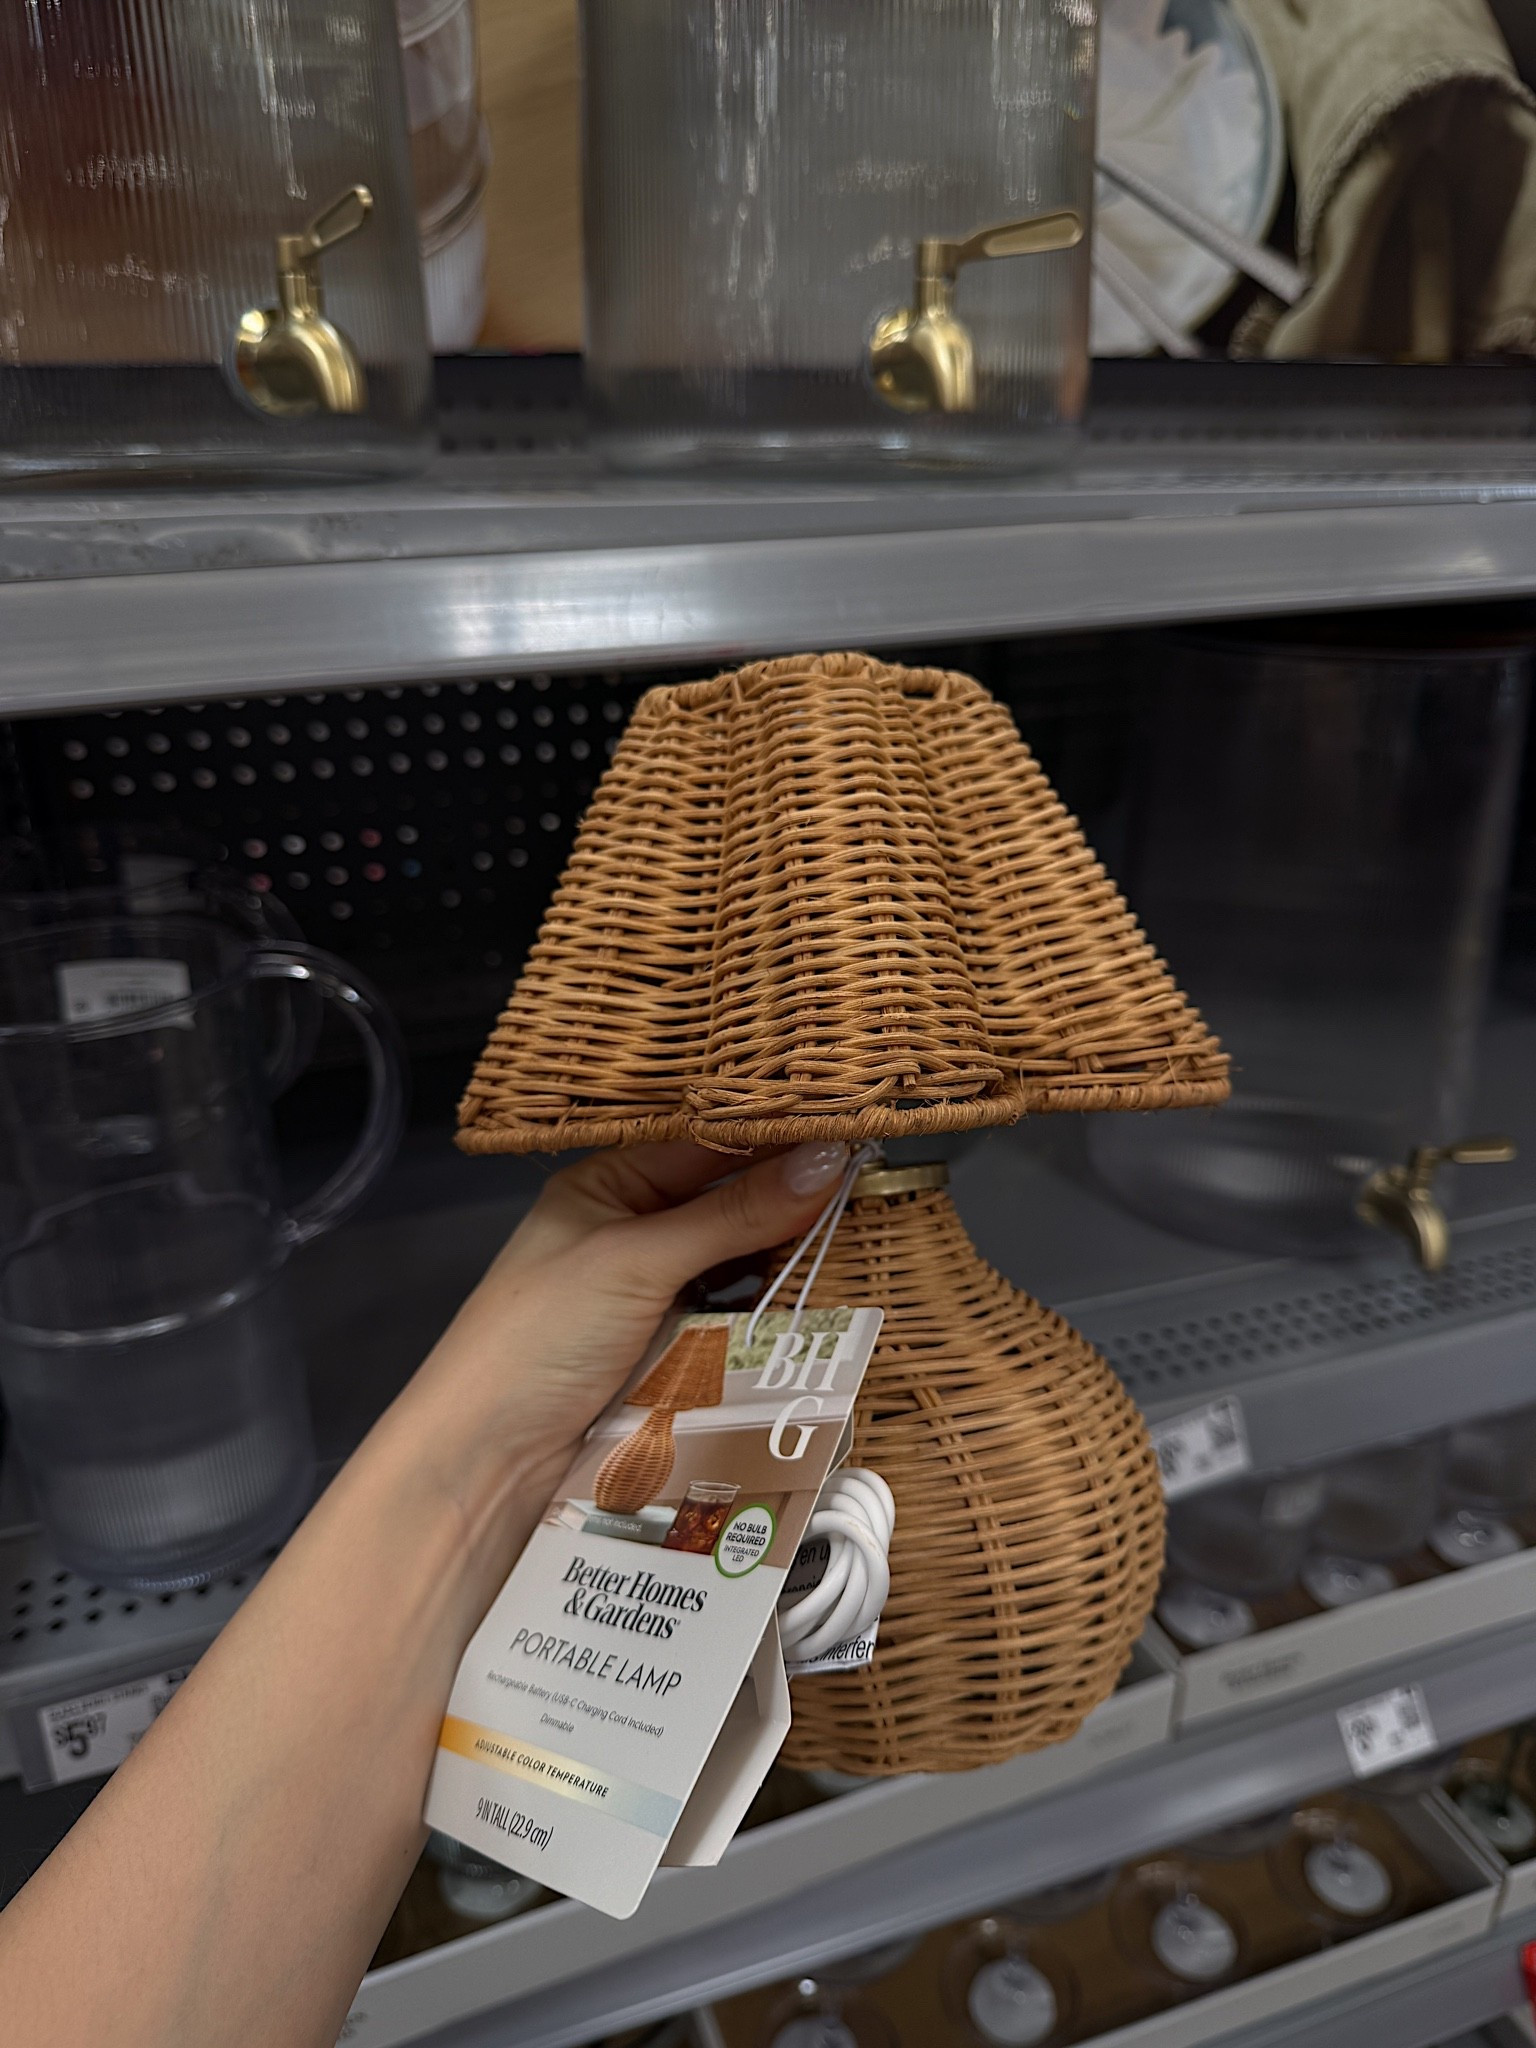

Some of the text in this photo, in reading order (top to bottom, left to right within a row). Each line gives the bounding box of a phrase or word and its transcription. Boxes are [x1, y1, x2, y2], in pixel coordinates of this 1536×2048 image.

[752, 1332, 856, 1391] BH
[768, 1395, 824, 1460] G
[724, 1544, 760, 1557] INTEGRATED
[725, 1531, 766, 1546] REQUIRED
[733, 1521, 767, 1535] NO BULB
[562, 1556, 708, 1612] Better Homes
[732, 1554, 744, 1562] LED
[509, 1628, 682, 1697] PORTABLE LAMP
[486, 1669, 664, 1738] Rechargeable Battery (USB-C Charging Cord Included)
[540, 1712, 574, 1732] Dimmable
[475, 1738, 609, 1798] ADJUSTABLE COLOR TEMPERATURE
[490, 1803, 510, 1831] TALL
[507, 1811, 534, 1839] (22.9
[530, 1826, 554, 1852] cm)
